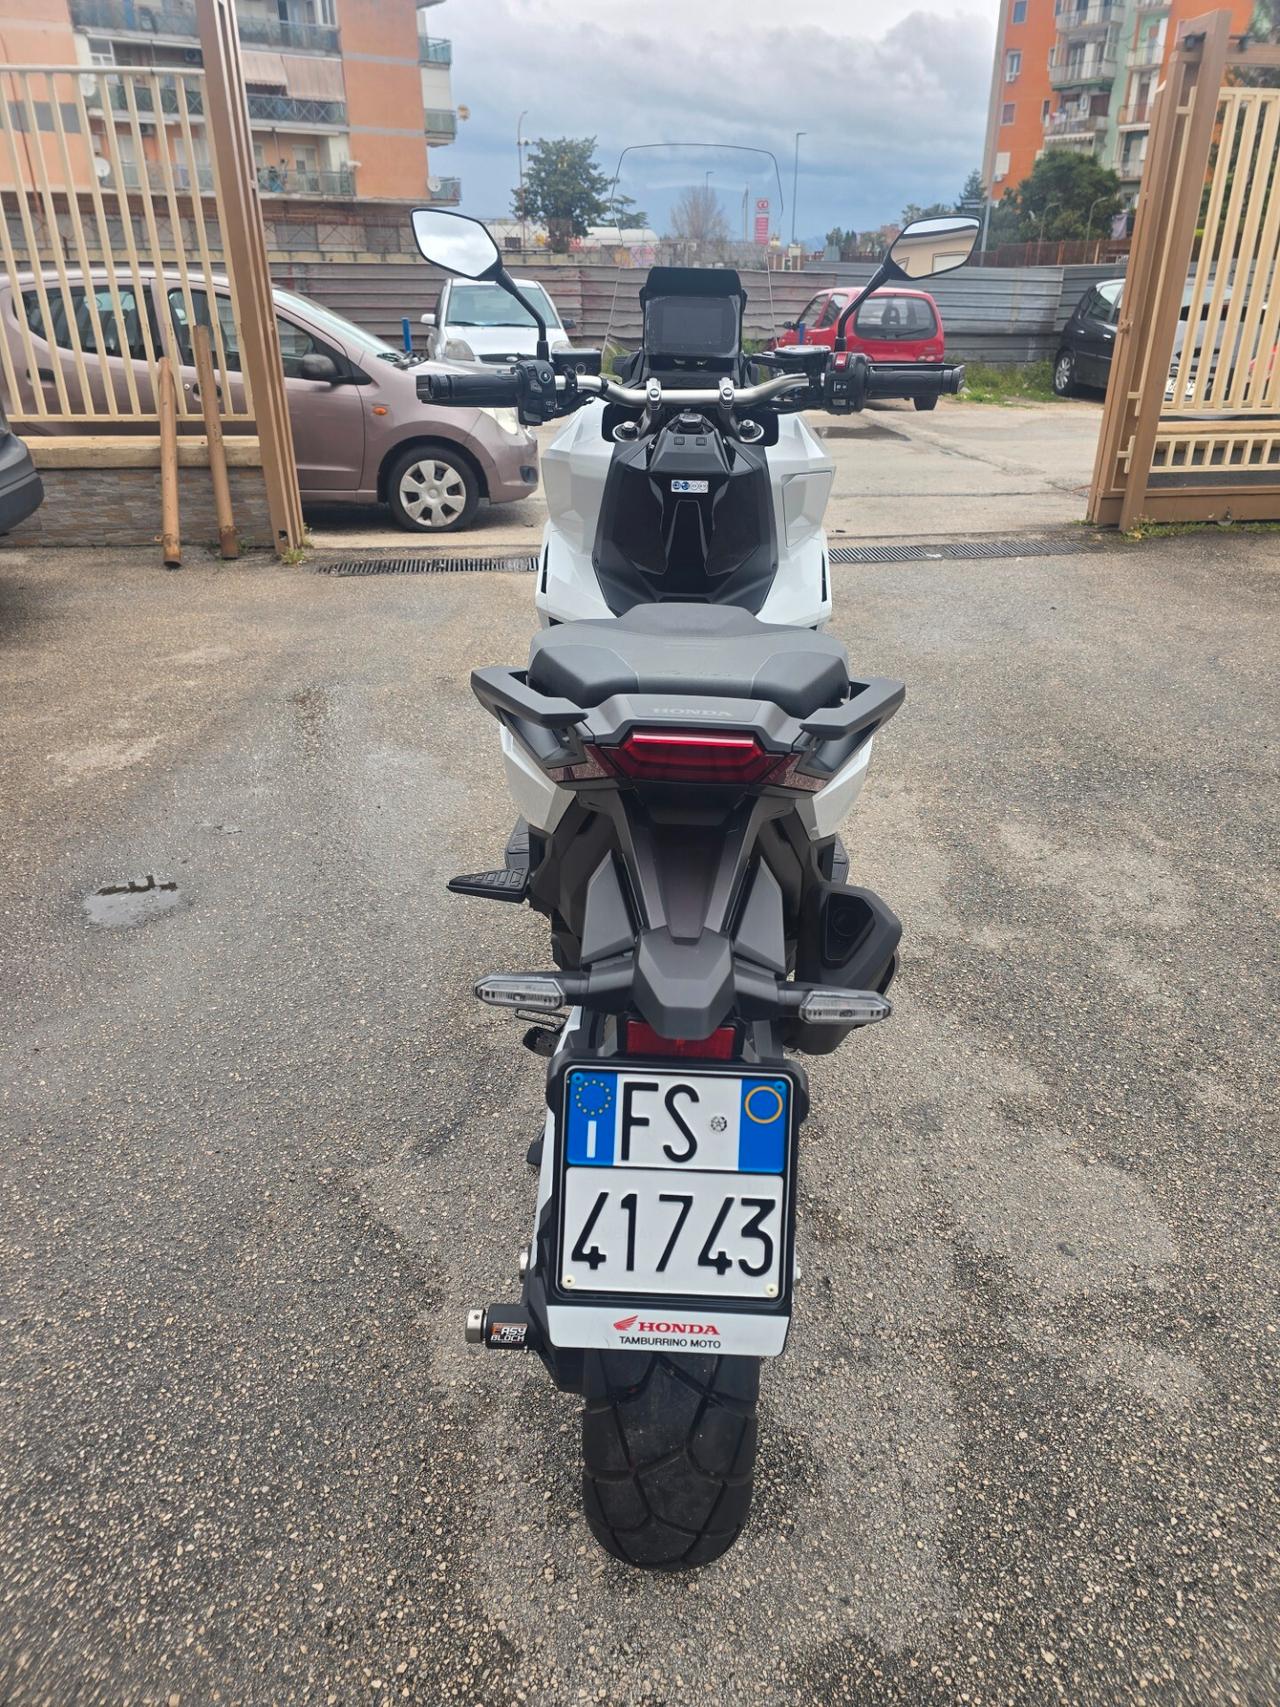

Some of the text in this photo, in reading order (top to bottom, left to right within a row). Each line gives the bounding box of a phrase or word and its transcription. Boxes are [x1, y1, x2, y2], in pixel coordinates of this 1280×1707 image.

[653, 707, 733, 718] HONDA
[621, 1081, 700, 1163] FS
[571, 1192, 776, 1277] 41743
[638, 1321, 720, 1336] HONDA
[619, 1336, 721, 1349] TAMBURRINO MOTO
